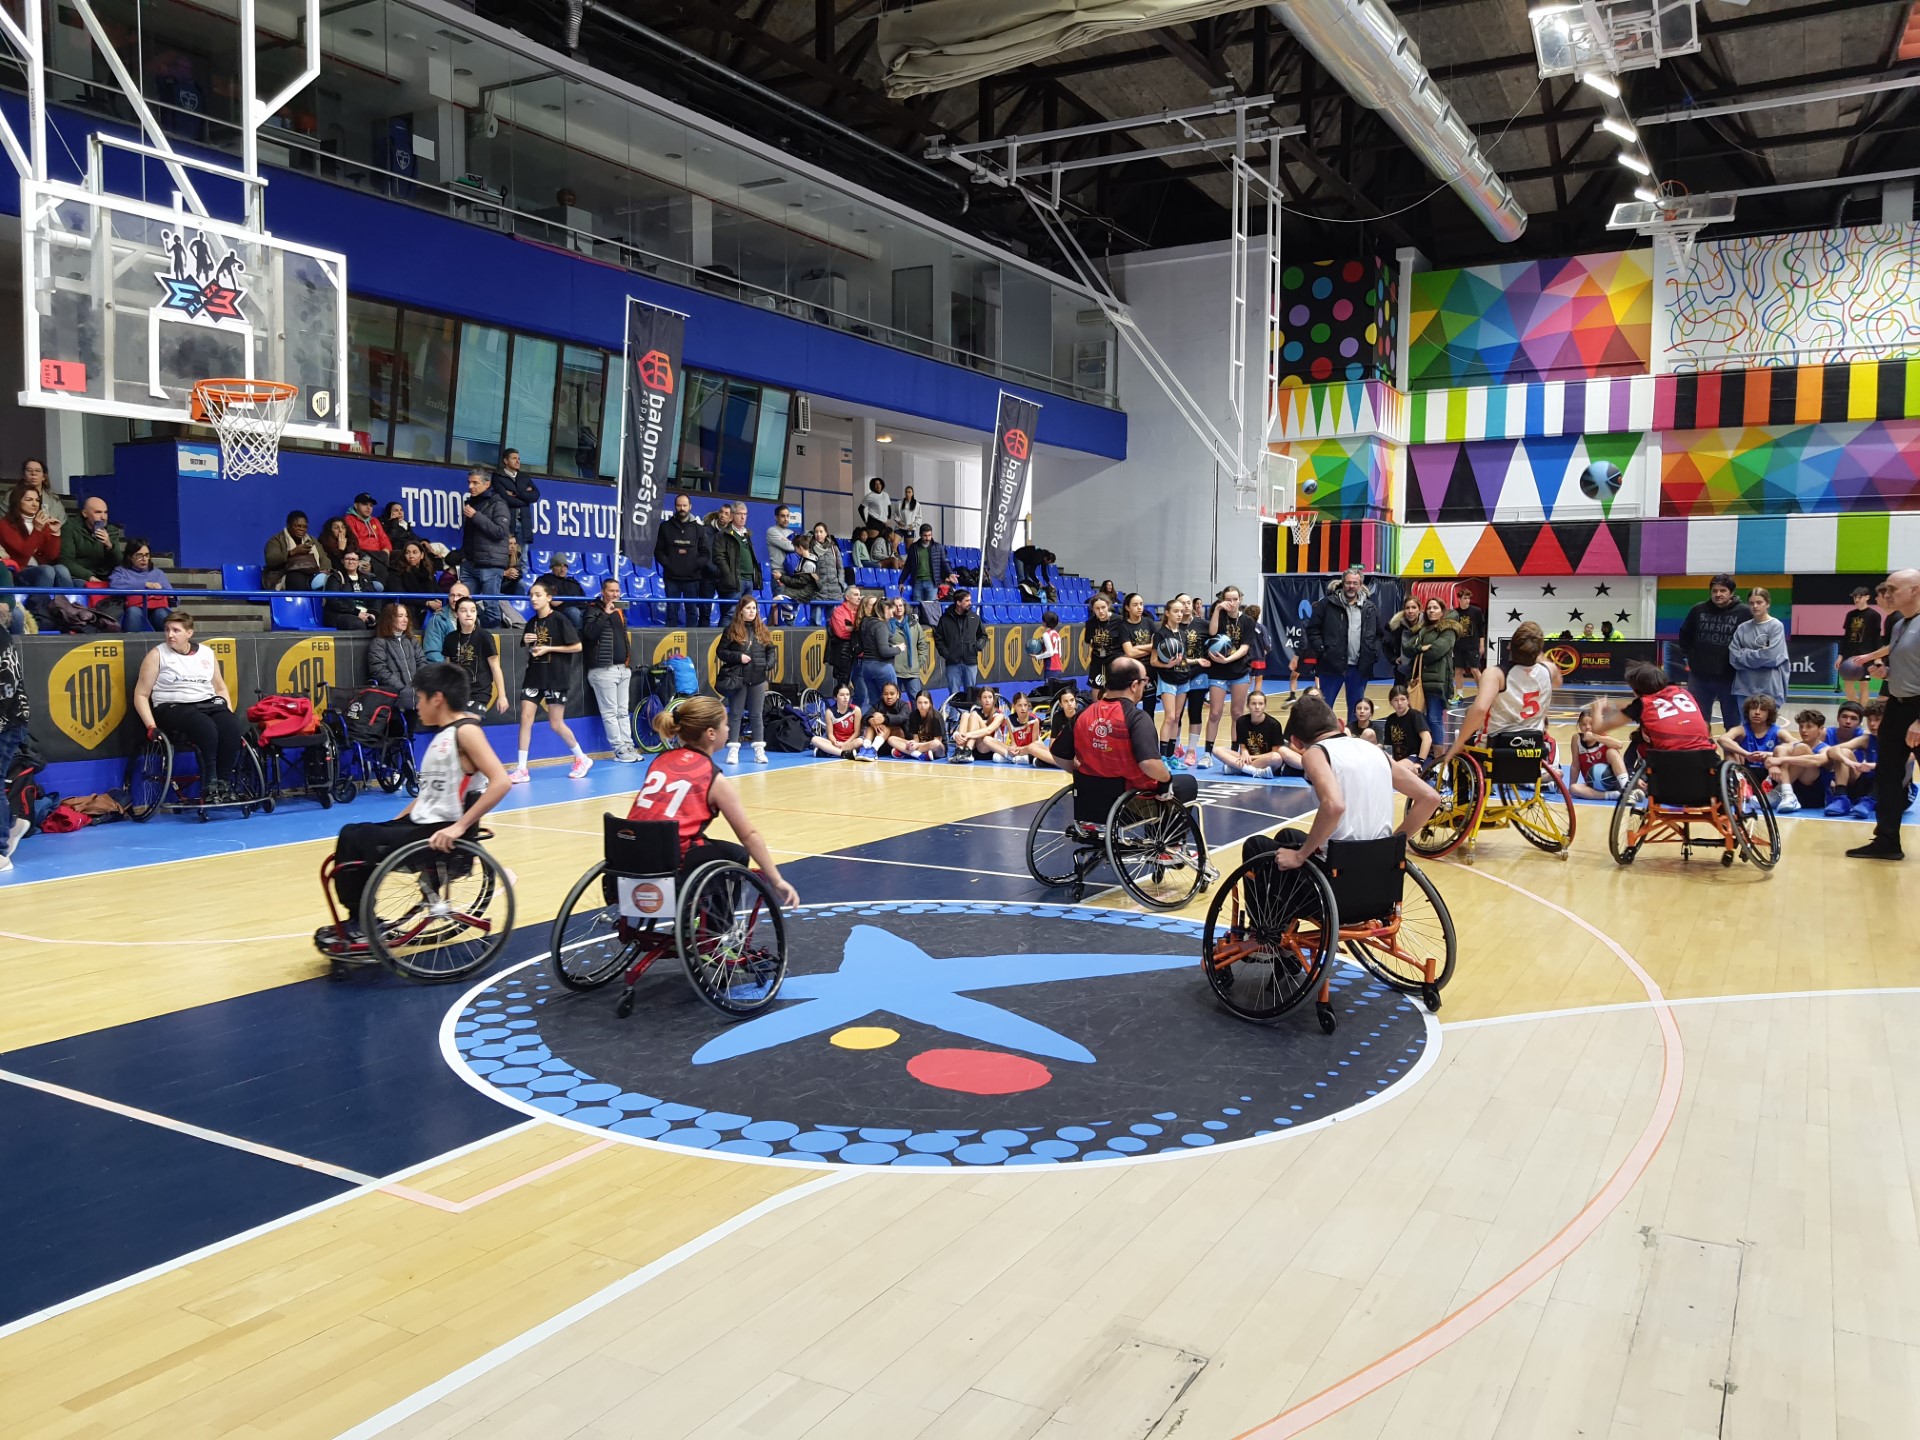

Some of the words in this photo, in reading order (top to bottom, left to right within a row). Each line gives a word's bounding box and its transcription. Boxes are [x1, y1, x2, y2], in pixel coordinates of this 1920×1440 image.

[188, 284, 219, 313] PLAZA
[53, 365, 65, 386] 1
[210, 643, 231, 654] FEB
[311, 641, 330, 651] FEB
[673, 635, 685, 643] FEB
[94, 646, 118, 658] FEB
[64, 664, 112, 730] 100
[1520, 691, 1540, 720] 5
[1652, 693, 1697, 720] 26
[636, 770, 693, 818] 21
